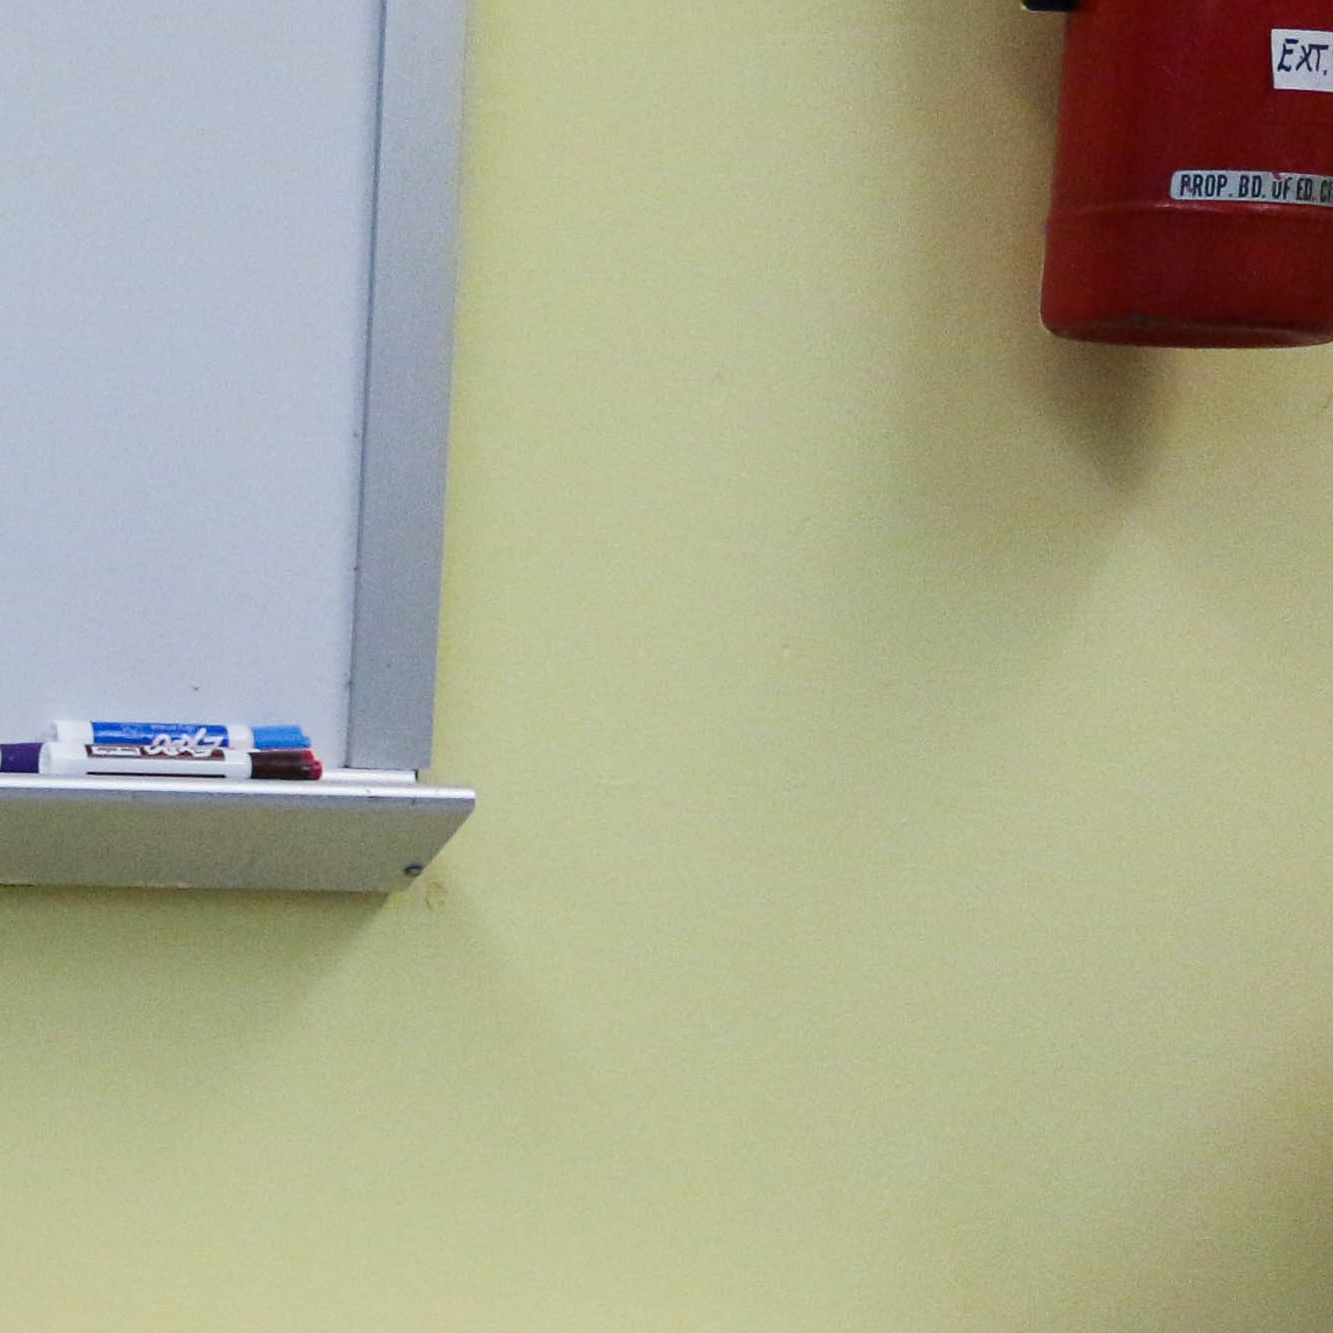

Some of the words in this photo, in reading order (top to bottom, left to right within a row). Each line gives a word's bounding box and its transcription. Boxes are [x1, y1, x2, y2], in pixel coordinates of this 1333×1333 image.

[1277, 38, 1329, 76] EXT.
[1180, 174, 1233, 198] PROP.
[1238, 175, 1266, 198] BD.
